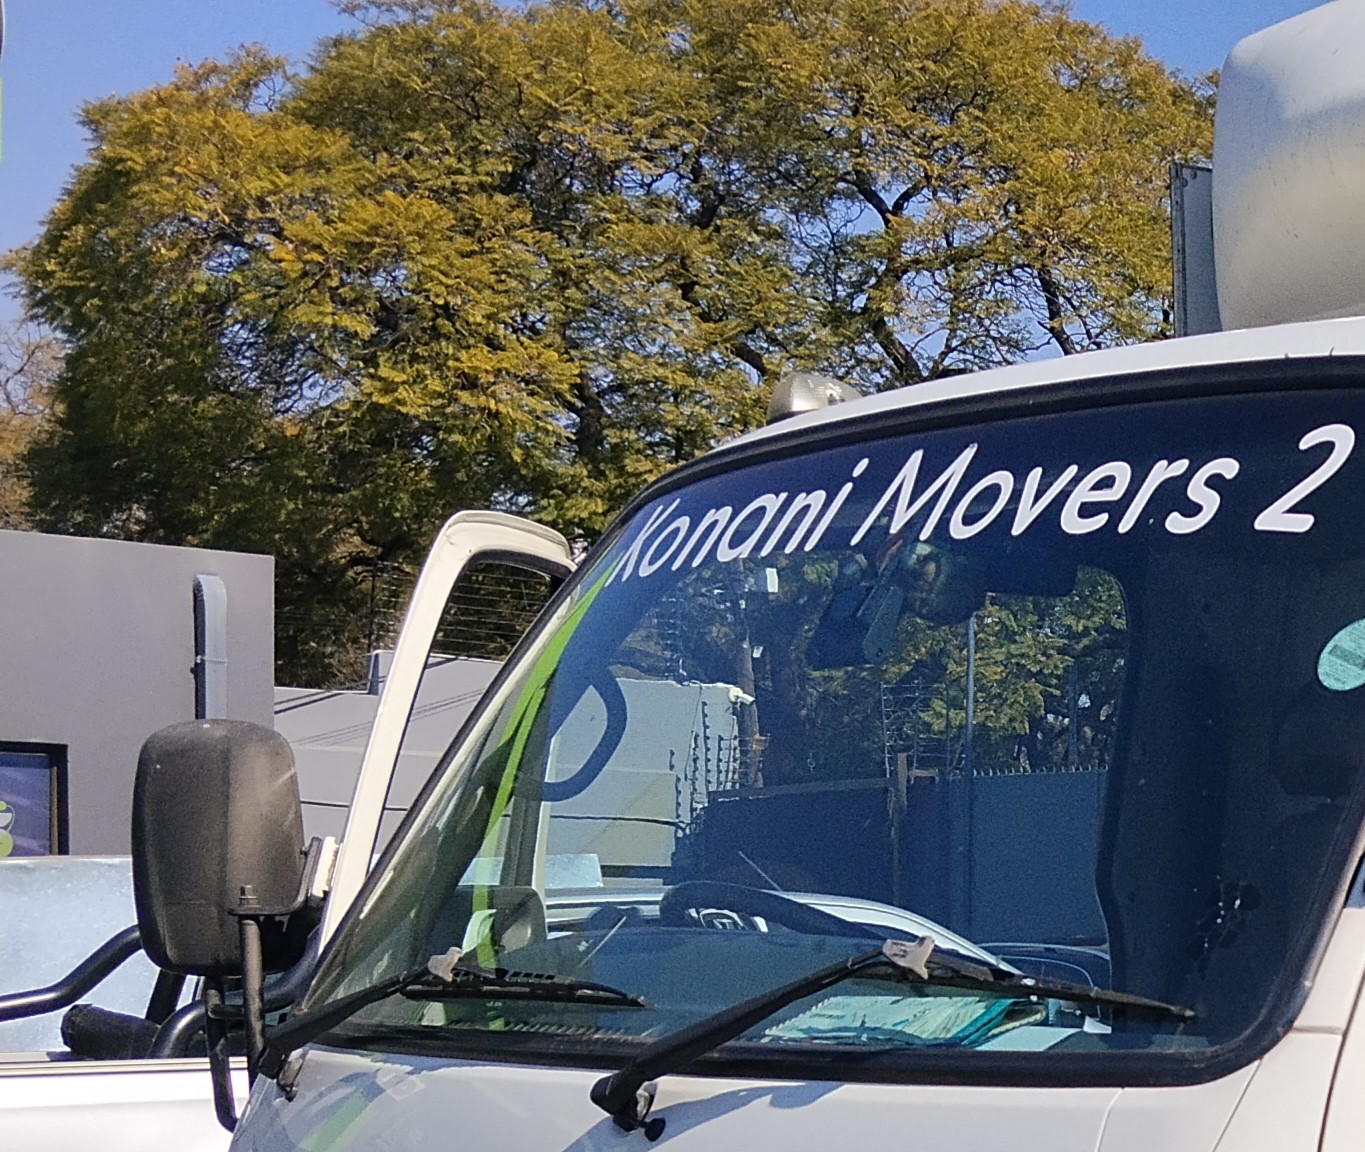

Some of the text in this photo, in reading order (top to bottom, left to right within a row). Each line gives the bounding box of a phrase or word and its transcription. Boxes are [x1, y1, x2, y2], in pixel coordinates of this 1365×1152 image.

[604, 457, 869, 587] Konani
[850, 442, 1240, 546] Movers
[1254, 423, 1355, 533] 2
